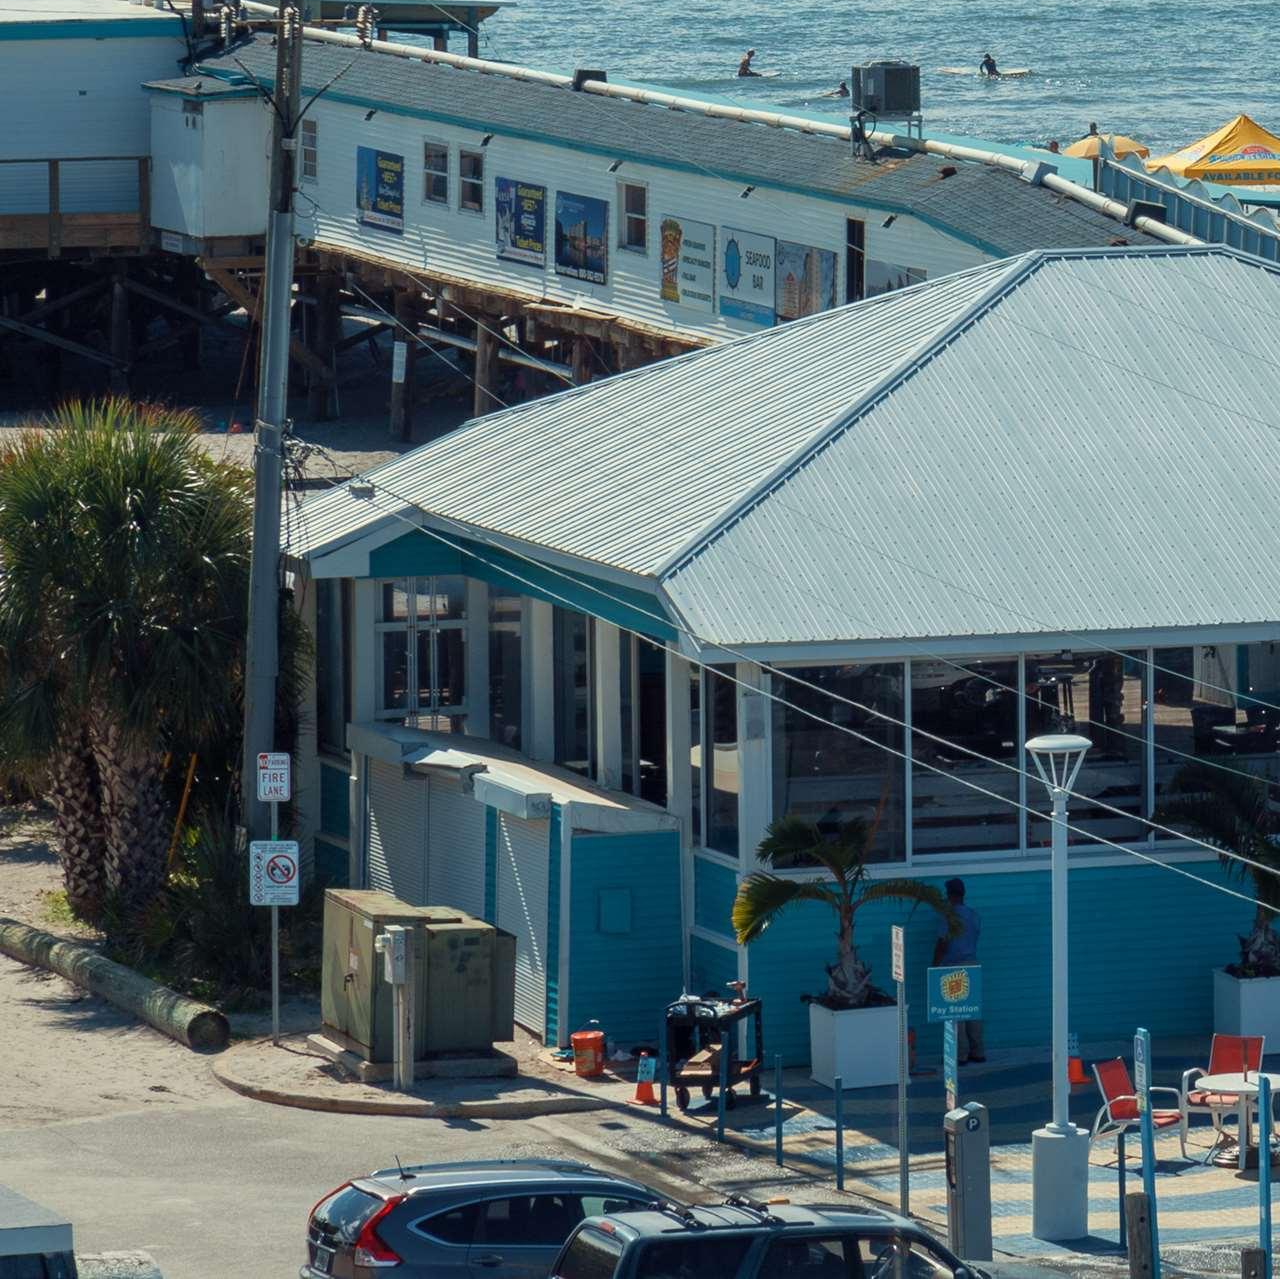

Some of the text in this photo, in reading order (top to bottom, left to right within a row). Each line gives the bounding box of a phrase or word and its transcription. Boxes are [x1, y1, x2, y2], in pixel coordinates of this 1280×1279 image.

[1202, 172, 1264, 181] AVAILABLE
[745, 250, 771, 270] SEAFOOD
[752, 274, 763, 290] BAR
[262, 773, 285, 783] FIRE
[263, 786, 284, 796] LANE
[931, 1007, 946, 1015] Pay
[969, 1119, 977, 1129] P
